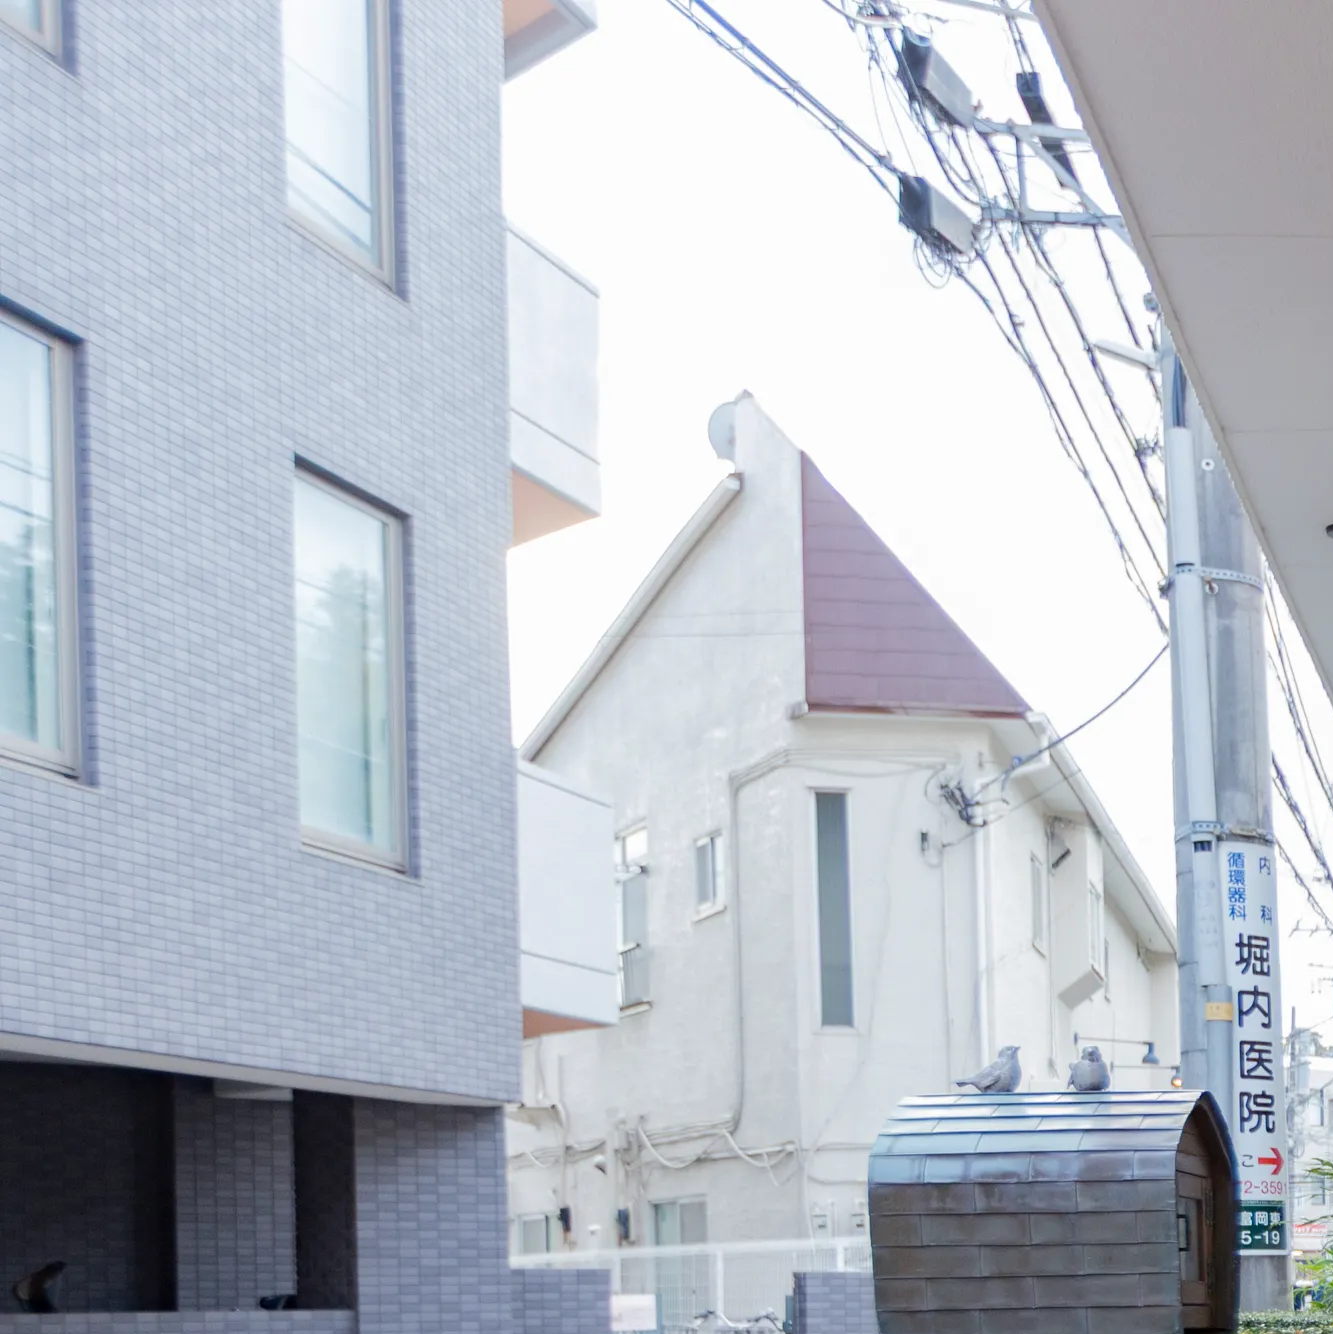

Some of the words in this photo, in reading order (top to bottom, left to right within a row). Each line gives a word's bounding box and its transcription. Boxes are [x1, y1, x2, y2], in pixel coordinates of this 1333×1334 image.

[1227, 851, 1247, 922] 循環器科
[1235, 932, 1276, 1134] 堀内医院
[1240, 1230, 1281, 1245] 5-19
